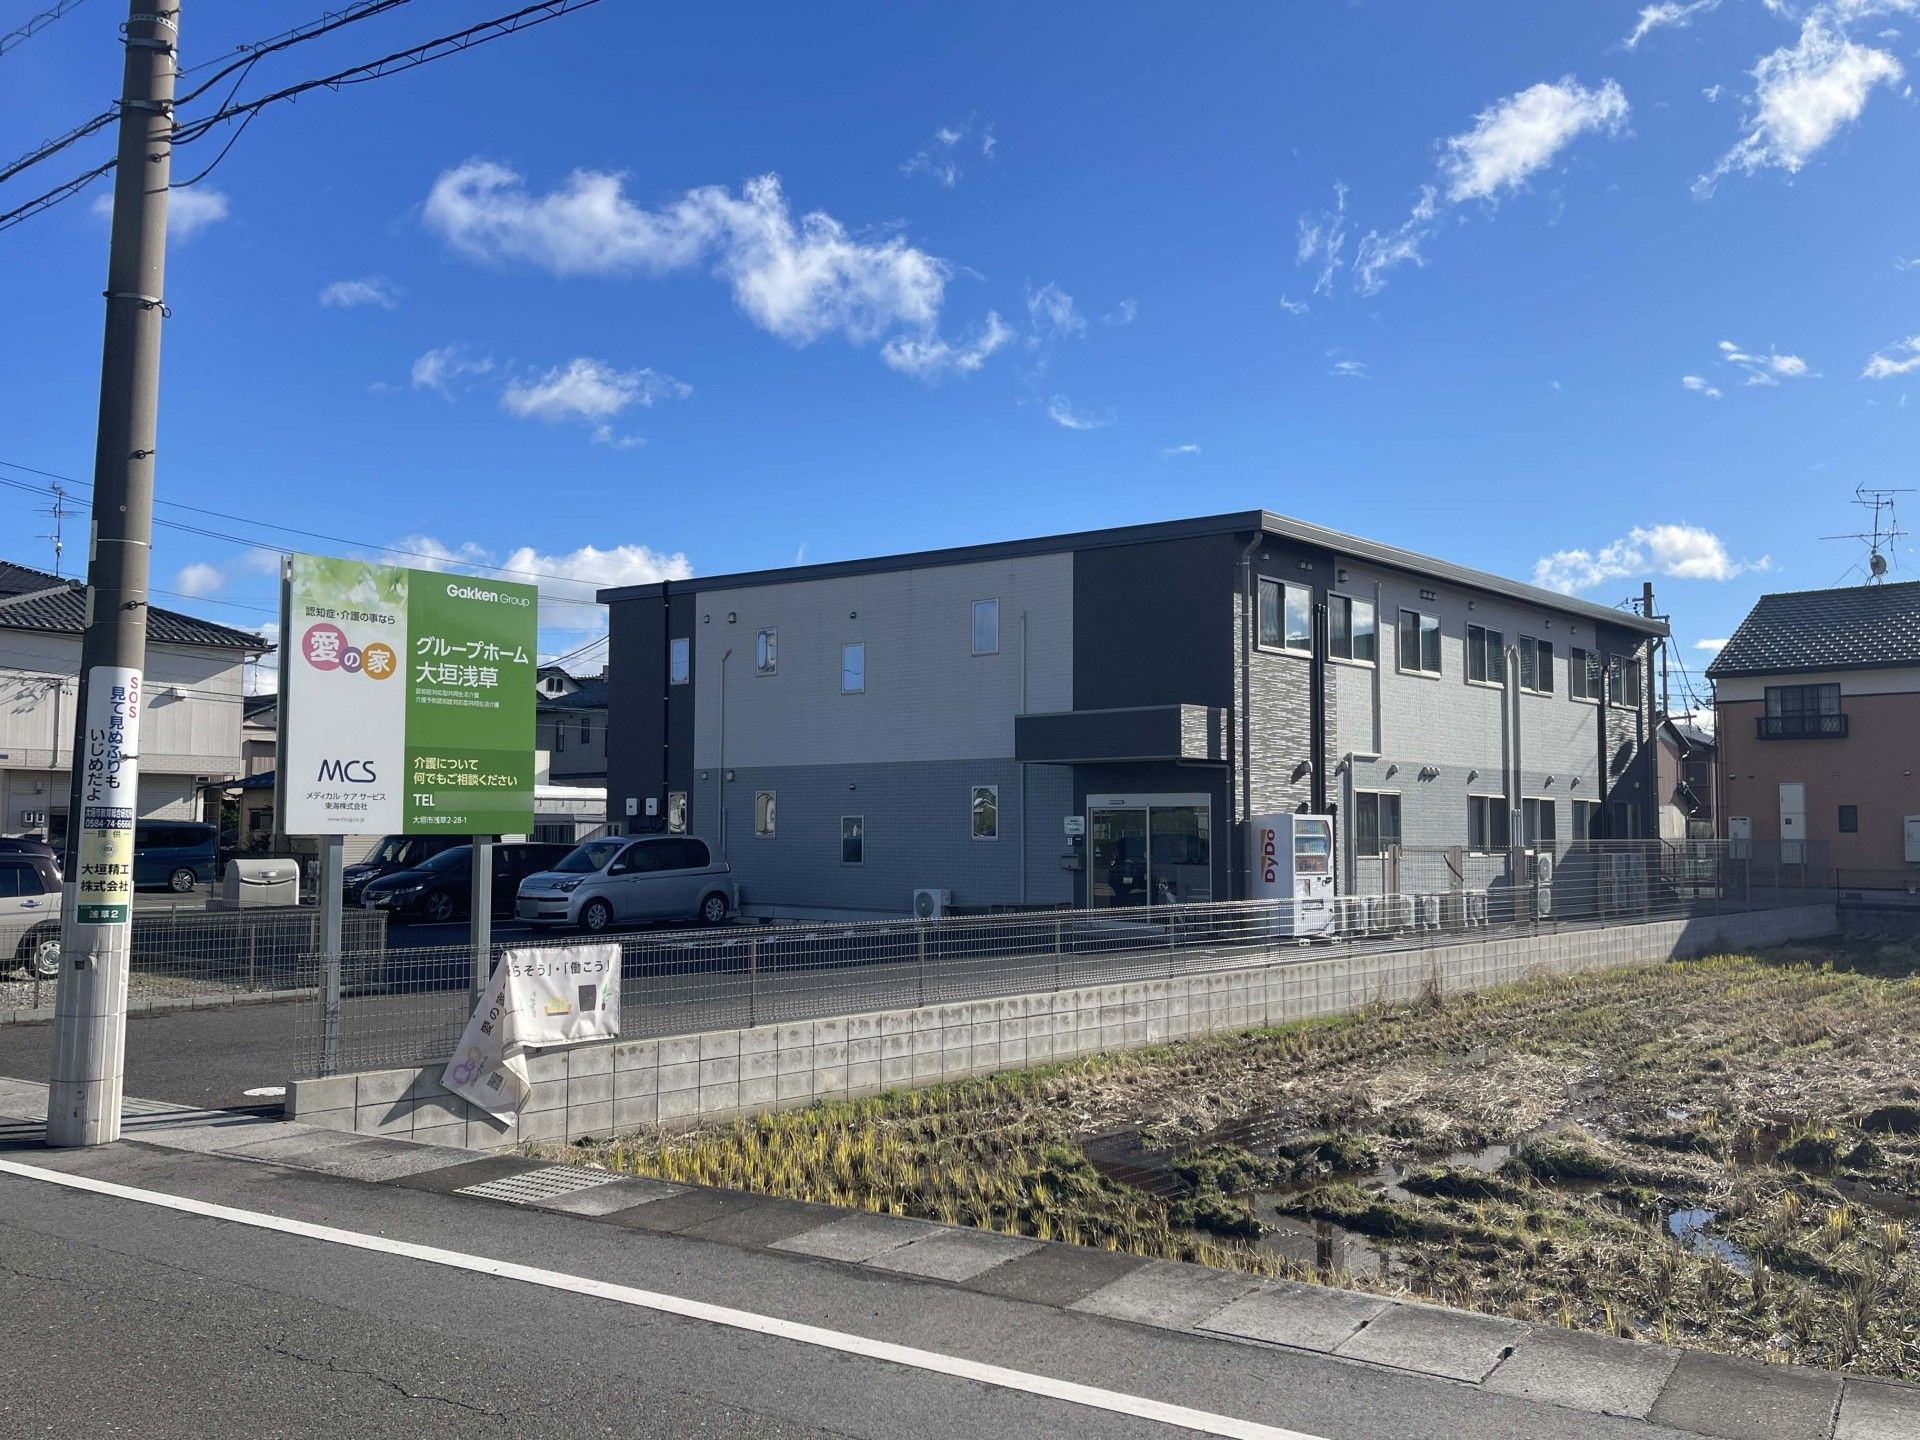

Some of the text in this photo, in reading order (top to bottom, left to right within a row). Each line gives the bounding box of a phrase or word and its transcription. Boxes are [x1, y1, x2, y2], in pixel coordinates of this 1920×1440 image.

[446, 584, 530, 608] Gakken Group
[305, 605, 396, 625] 認知症・介護の事なら
[310, 631, 391, 673] 愛の家
[416, 635, 529, 665] グループホーム
[416, 661, 499, 689] 大垣浅草
[128, 677, 139, 719] SOS
[105, 686, 125, 789] 見て見ぬふりも
[86, 728, 106, 802] いじめだよ
[317, 758, 377, 784] MCS
[413, 756, 479, 771] 介護について
[413, 772, 518, 787] 何でもご相談ください
[324, 802, 368, 811] 東海株式会社
[412, 793, 436, 807] TEL
[412, 815, 468, 825] 大垣市浅草2-28-1
[1264, 829, 1279, 883] DyDo
[81, 863, 129, 875] 大垣精工
[80, 880, 129, 892] 株式会社
[88, 909, 119, 919] 浅草2
